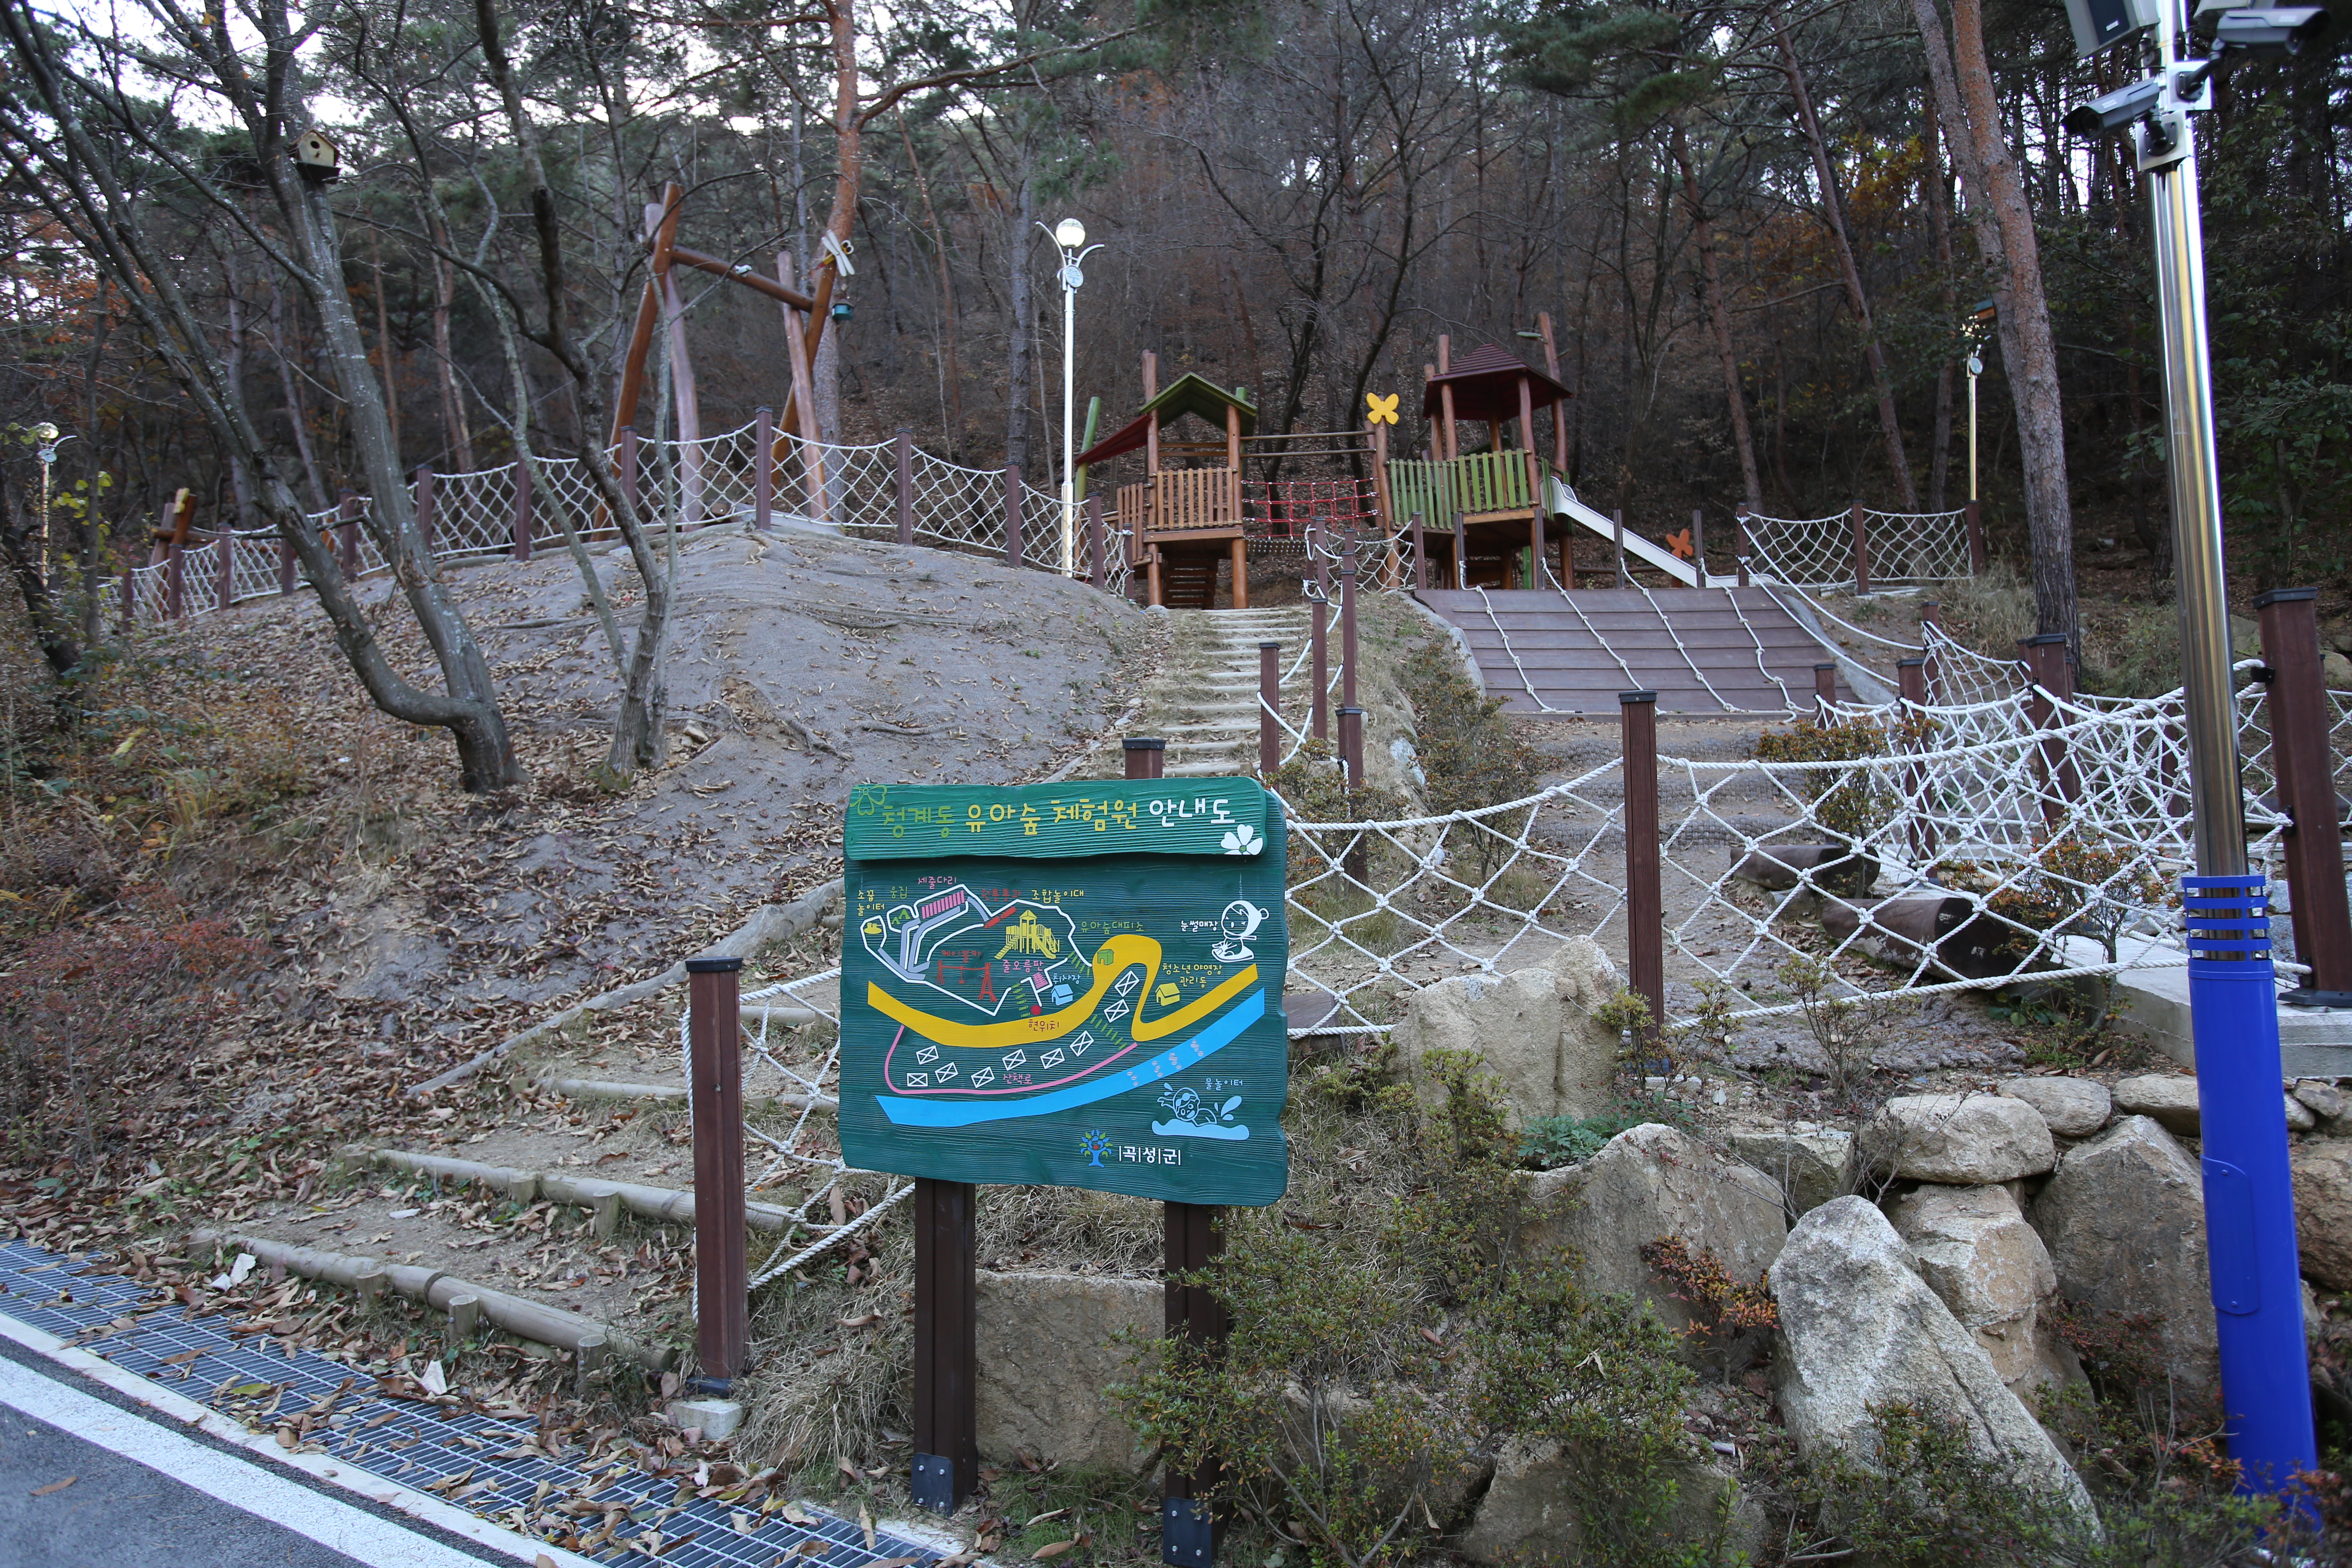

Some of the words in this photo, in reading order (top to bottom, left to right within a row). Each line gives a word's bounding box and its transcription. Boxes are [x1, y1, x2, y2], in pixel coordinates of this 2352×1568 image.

[882, 805, 955, 838] 청계동
[965, 803, 1041, 835] 유아숲
[1051, 798, 1137, 831] 체험원
[1149, 798, 1235, 827] 안내도
[890, 886, 907, 899] 움집
[857, 903, 885, 916] 놀이터
[1181, 920, 1218, 932] 눈썰매장
[941, 949, 982, 963] 케이블카
[1002, 959, 1044, 973] 줄오름판
[1053, 973, 1081, 984] 취사장
[1179, 976, 1207, 988] 관리동
[1029, 1019, 1059, 1032] 현위치
[1003, 1073, 1033, 1084] 산책로
[1205, 1078, 1243, 1090] 물놀이터
